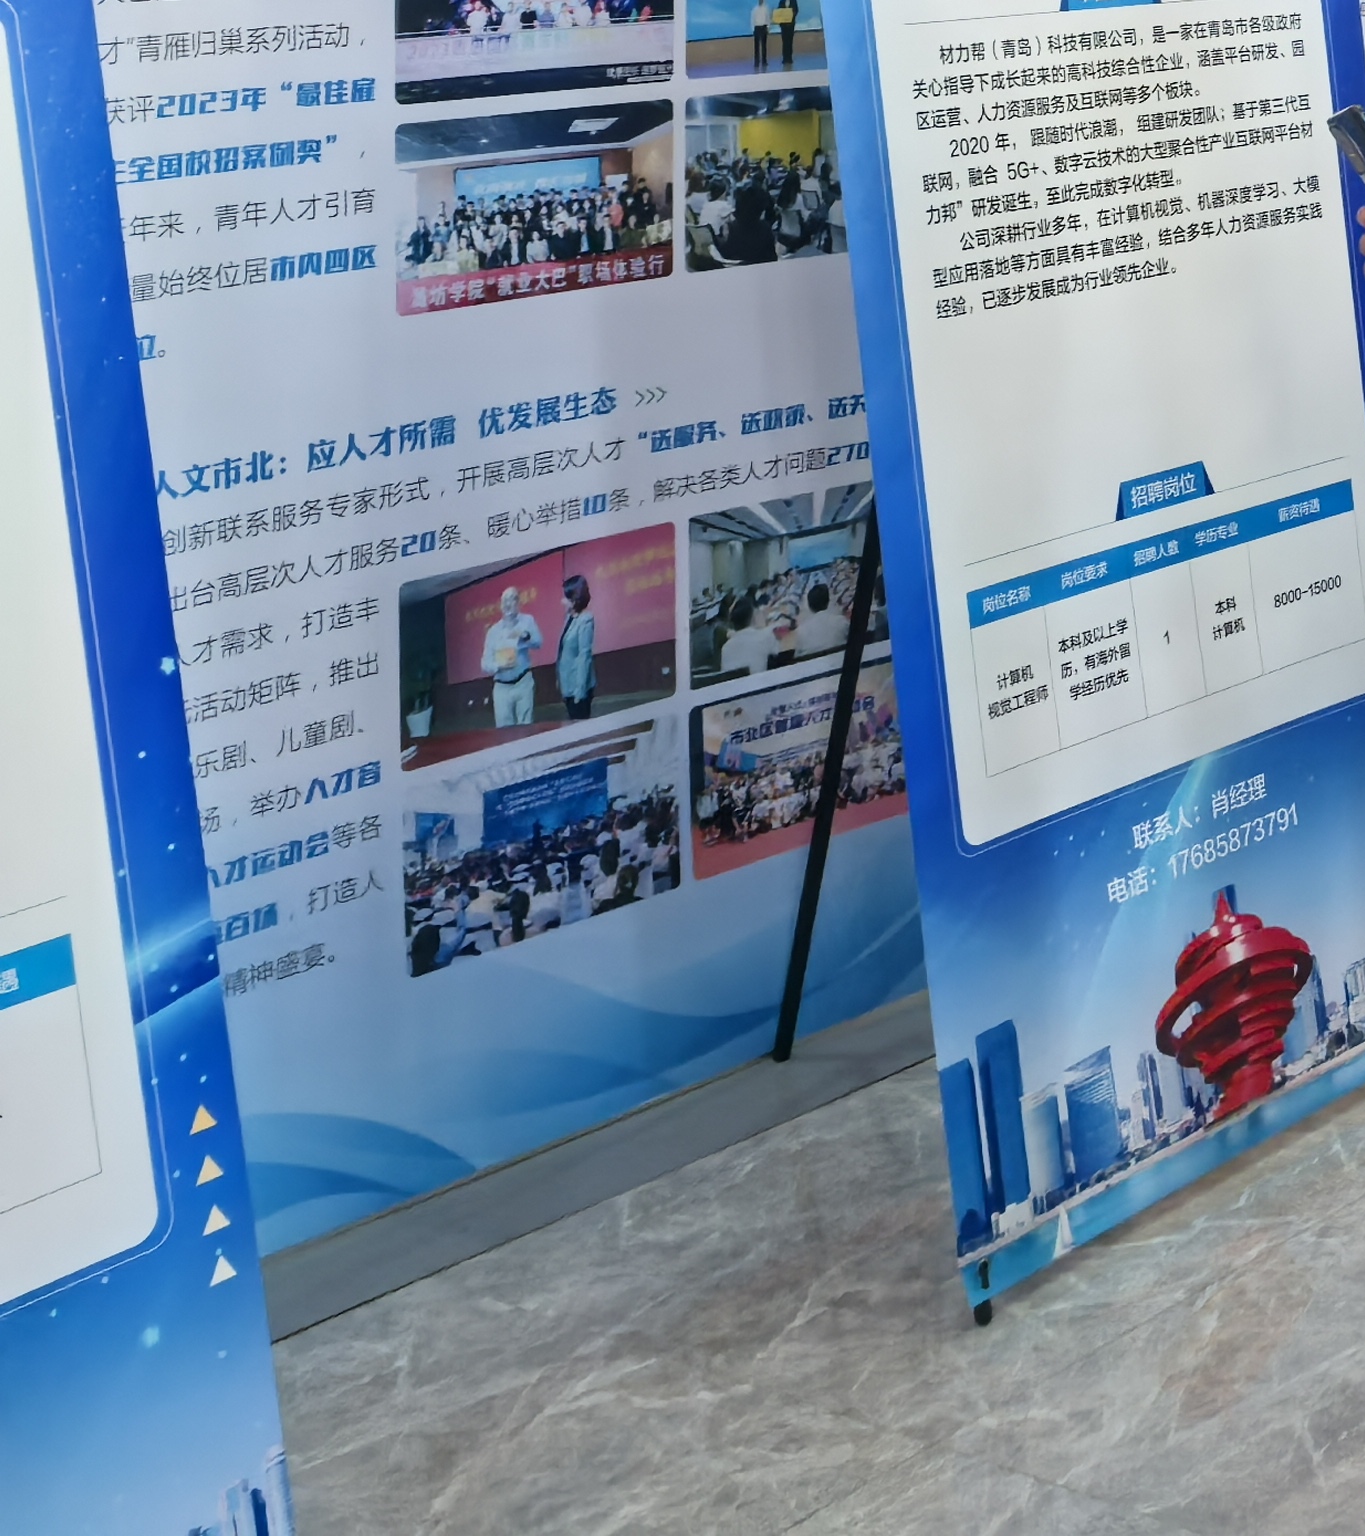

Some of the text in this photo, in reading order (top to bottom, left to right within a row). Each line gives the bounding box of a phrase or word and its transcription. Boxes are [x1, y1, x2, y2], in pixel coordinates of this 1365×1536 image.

[913, 39, 1305, 99] 关心指导下成长起来的高科技综合性企业，涵盖平台研发、园
[916, 80, 1201, 131] 区运营、人力资源服务及互联网等多个板块。
[949, 135, 990, 158] 2020
[121, 187, 376, 242] 年来，青年人才引育
[960, 175, 1321, 251] 公司深耕行业多年，在计算机视觉、机器深度学习、大模
[932, 202, 1323, 289] 型应用落地等方面具有丰富经验，结合多年人力资源服务实践
[936, 257, 1177, 320] 经验，已逐步发展成为行业领先企业。
[478, 386, 617, 439] 优发展生态
[1130, 472, 1198, 510] 招聘岗位
[1194, 521, 1239, 547] 学历专业
[1133, 539, 1180, 568] 招聘人数
[1060, 561, 1109, 589] 岗位要求
[1273, 575, 1342, 609] 8000-15000
[1214, 596, 1237, 616] 本科
[1057, 618, 1130, 653] 本科及以上学
[1211, 617, 1246, 641] 计算机
[996, 664, 1035, 691] 计算机
[1060, 642, 1132, 680] 历，有海外留
[1068, 668, 1130, 701] 学经历优先
[987, 685, 1049, 720] 视觉工程师
